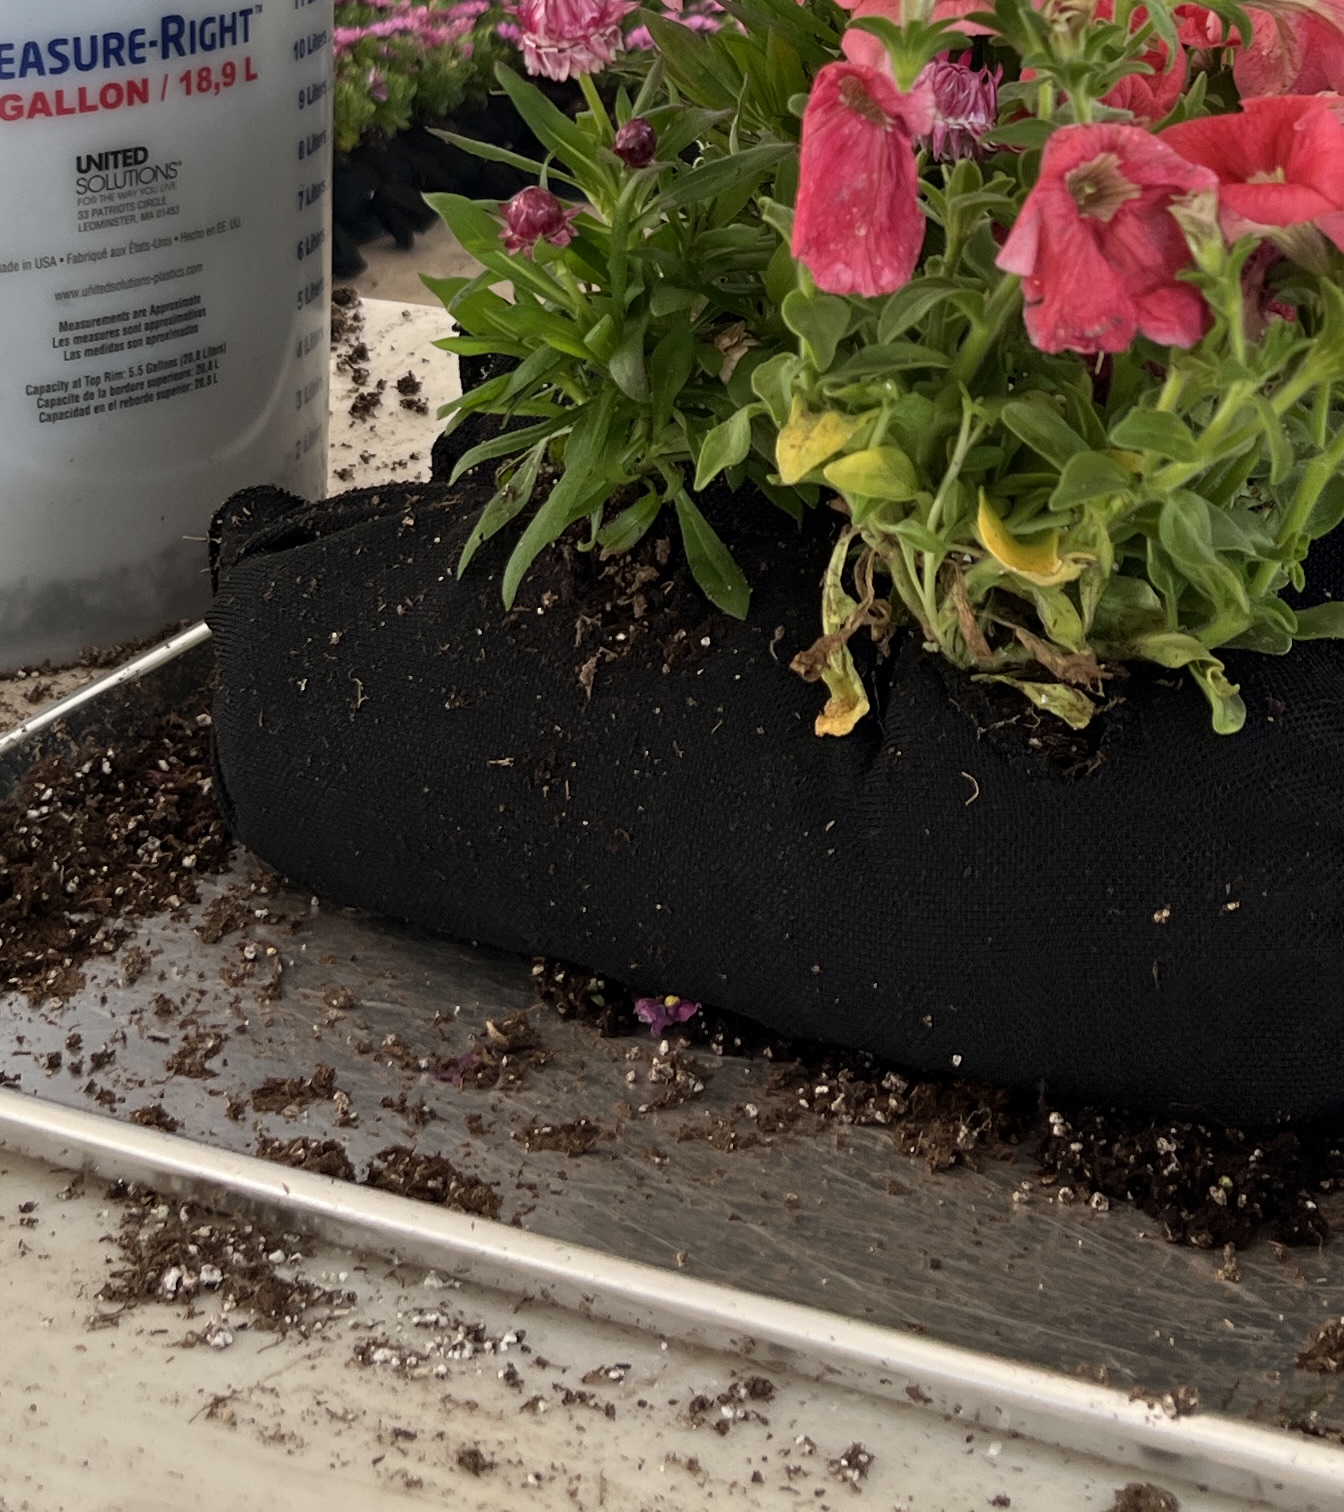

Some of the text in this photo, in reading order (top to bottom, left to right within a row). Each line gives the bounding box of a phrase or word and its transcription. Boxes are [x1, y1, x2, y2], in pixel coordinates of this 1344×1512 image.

[293, 39, 306, 61] 10
[160, 74, 168, 101] /
[179, 61, 236, 96] 18,9
[245, 56, 259, 82] L
[298, 90, 305, 110] 9
[76, 146, 149, 174] UNITED
[77, 196, 97, 206] FOR
[78, 196, 167, 220] 33 PATRIOTS CIRCLE
[141, 210, 154, 221] MA
[22, 259, 32, 270] in
[35, 256, 57, 269] USA
[67, 247, 108, 264] Fabriqué
[110, 248, 126, 257] aux
[54, 263, 203, 301] www.unitedsolutions-plastics.com
[59, 295, 201, 333] Measurements are Approximate
[52, 337, 70, 348] Les
[73, 328, 120, 345] measures
[122, 322, 142, 336] sont
[64, 350, 81, 361] Las
[84, 341, 125, 358] medidas
[127, 338, 143, 349] son
[26, 380, 70, 396] Capacity
[72, 378, 82, 389] at
[84, 375, 101, 387] Top
[146, 358, 178, 374] Gallons
[83, 390, 95, 402] de
[97, 388, 107, 399] la
[39, 405, 91, 424] Capacidad
[94, 403, 105, 414] en
[108, 400, 117, 411] el
